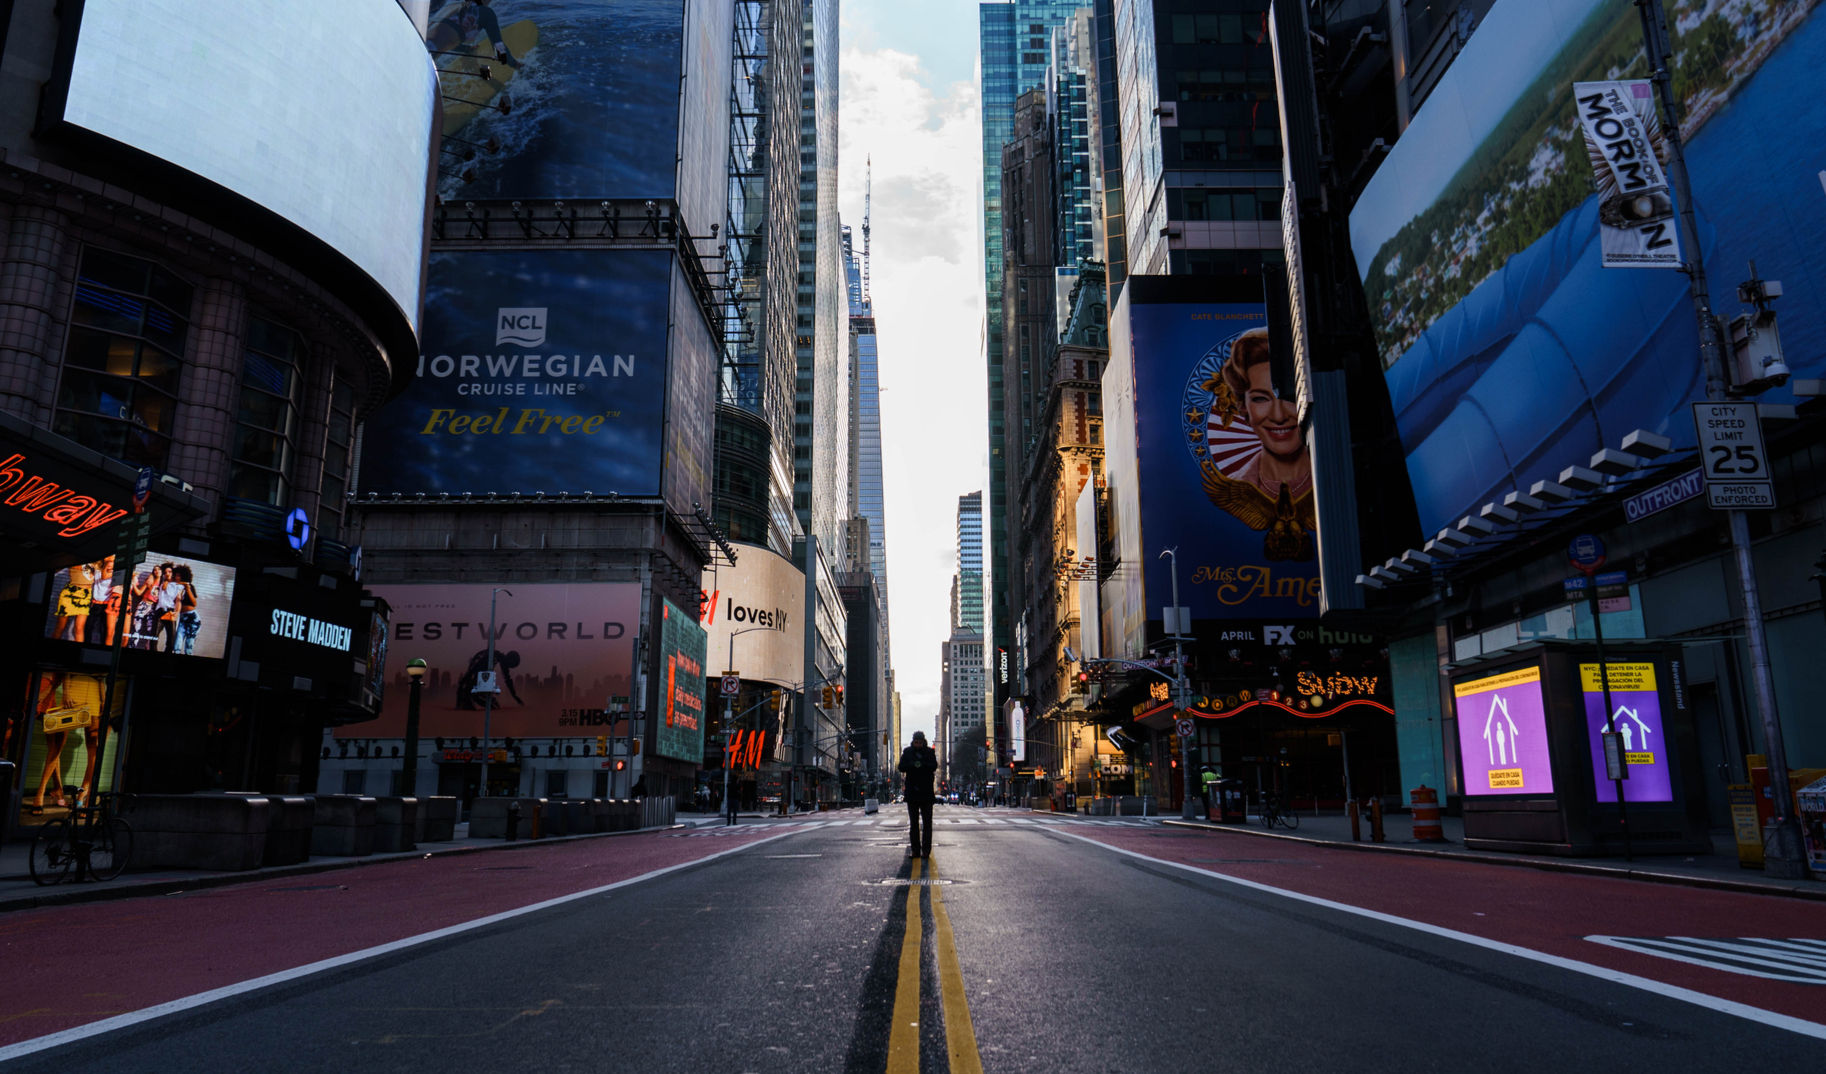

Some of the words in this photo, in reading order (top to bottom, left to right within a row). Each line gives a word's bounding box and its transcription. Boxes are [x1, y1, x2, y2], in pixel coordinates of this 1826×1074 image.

[1605, 88, 1628, 115] THE
[1622, 117, 1648, 159] BOOK
[1642, 163, 1659, 184] OF
[501, 316, 543, 330] NCL
[458, 383, 526, 396] CRUISE
[420, 406, 509, 435] Feel
[1711, 407, 1737, 416] CITY
[1708, 419, 1745, 428] SPEED
[1714, 432, 1744, 441] LIMIT
[1710, 445, 1759, 474] 25
[1627, 471, 1700, 519] OUTFRONT
[1723, 486, 1756, 495] PHOTO
[1715, 496, 1768, 504] ENFORCED
[1190, 566, 1236, 585] Mrs.
[1564, 579, 1583, 590] M42
[1566, 591, 1584, 600] MTA
[727, 597, 773, 628] loves
[776, 607, 788, 633] NY
[270, 608, 307, 642] STEVE
[307, 618, 352, 652] MADDEN
[1220, 630, 1255, 641] APRIL
[1263, 625, 1296, 646] FX
[1298, 630, 1314, 640] ON
[998, 652, 1008, 684] verizon
[1671, 661, 1686, 710] Newsstand
[561, 708, 578, 718] 3.15
[580, 708, 620, 726] HBO
[559, 718, 577, 727] 9PM
[722, 728, 766, 770] H&M
